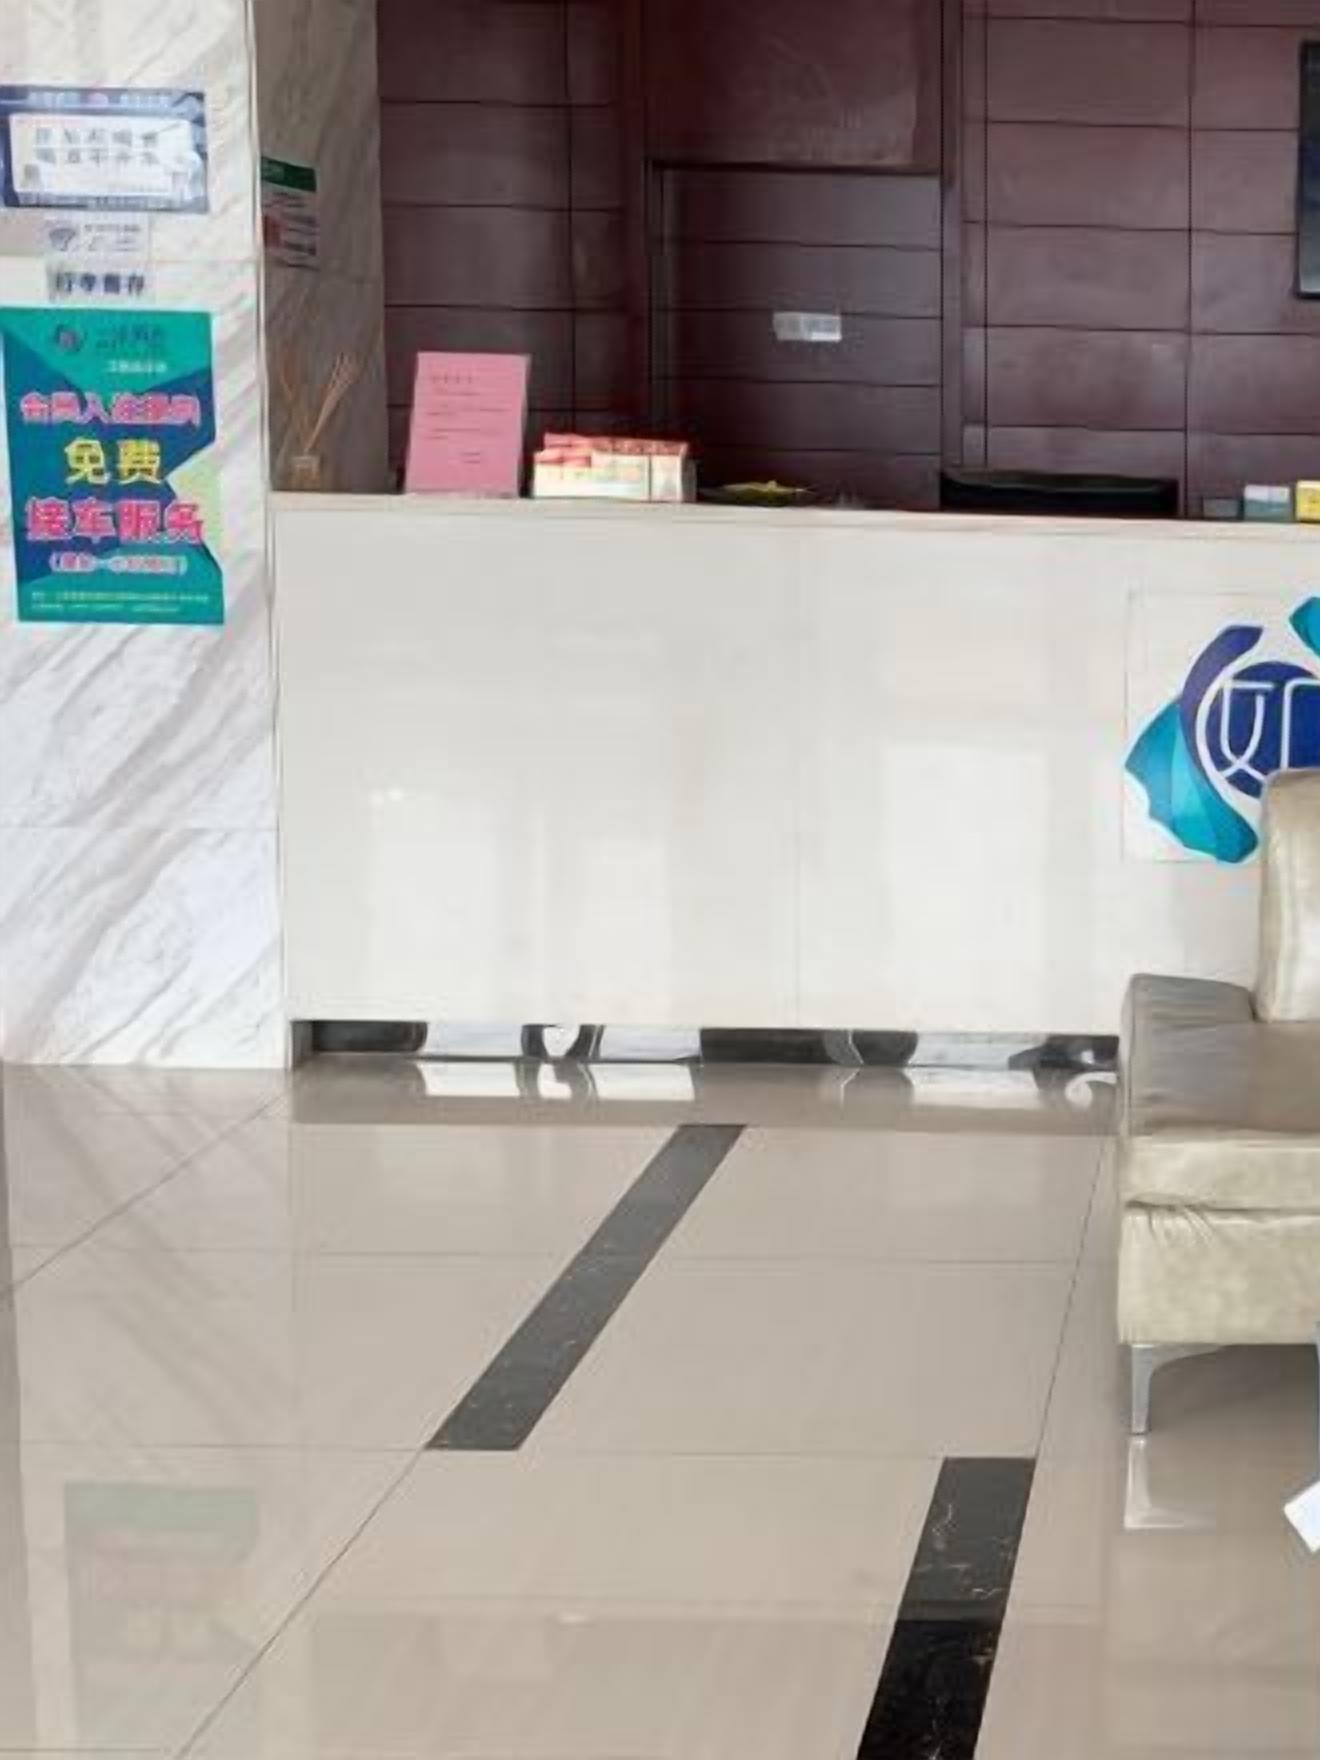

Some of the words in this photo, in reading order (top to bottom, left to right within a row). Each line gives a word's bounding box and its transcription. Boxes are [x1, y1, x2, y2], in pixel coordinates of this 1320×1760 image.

[64, 437, 162, 485] 免费
[25, 497, 205, 545] 接车服务
